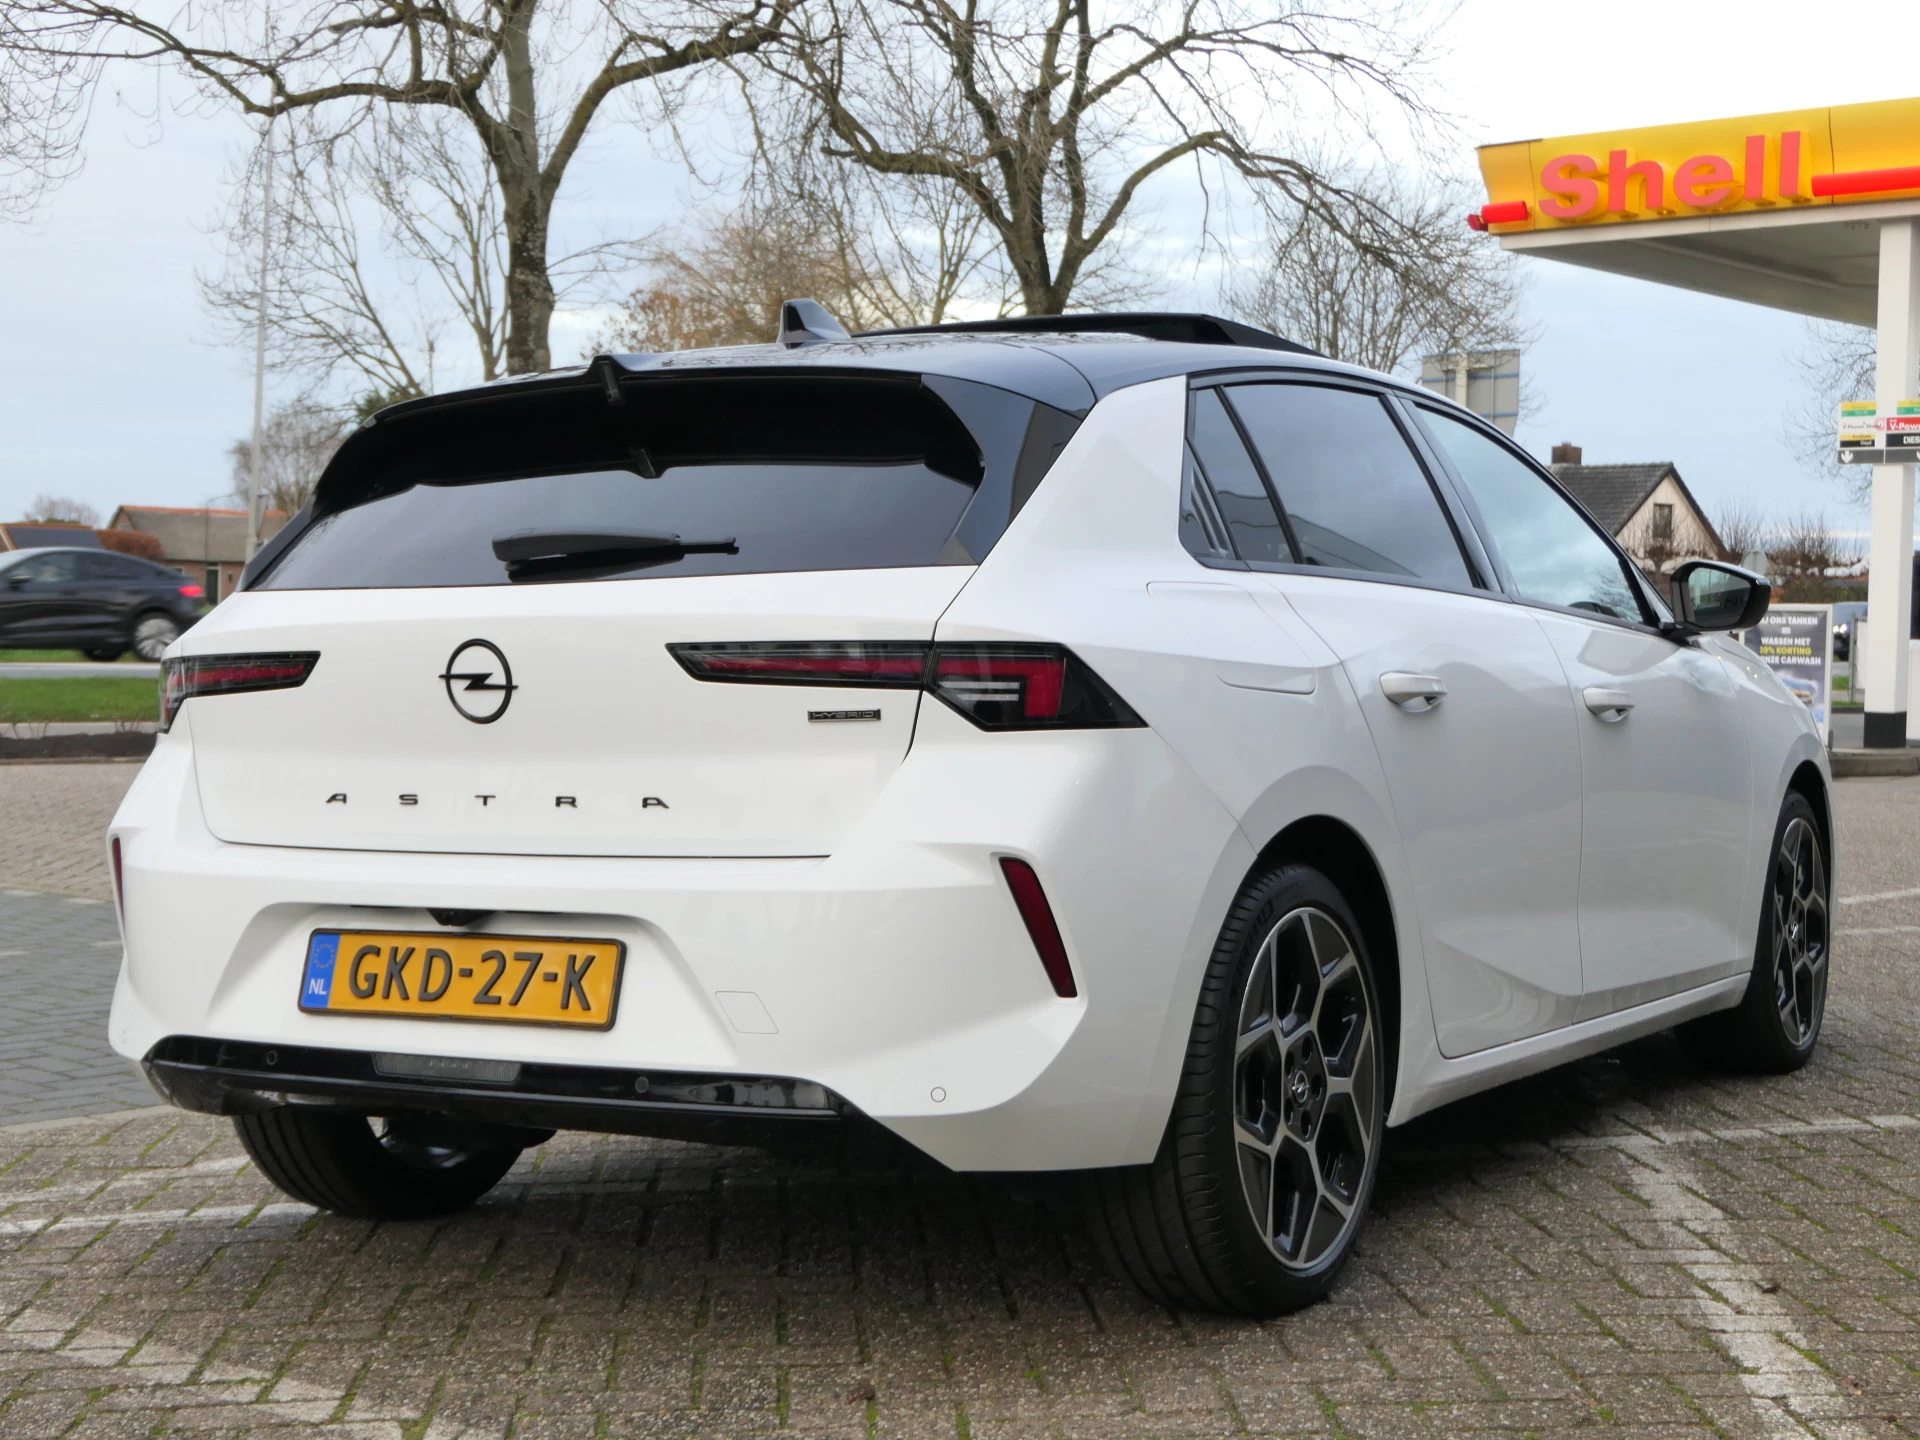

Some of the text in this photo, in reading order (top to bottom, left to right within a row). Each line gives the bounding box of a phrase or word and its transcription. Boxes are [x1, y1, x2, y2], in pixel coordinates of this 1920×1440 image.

[1538, 131, 1804, 219] Shell
[1769, 616, 1787, 624] ONS
[1787, 616, 1818, 625] TANKEN
[1761, 637, 1811, 646] WASSEN MET
[1776, 646, 1812, 655] KORTING
[1780, 656, 1822, 665] CARWASH
[812, 710, 875, 719] HYBRID
[326, 792, 670, 809] ASTRA
[349, 944, 597, 1011] GKD-27-K
[308, 977, 327, 996] NL
